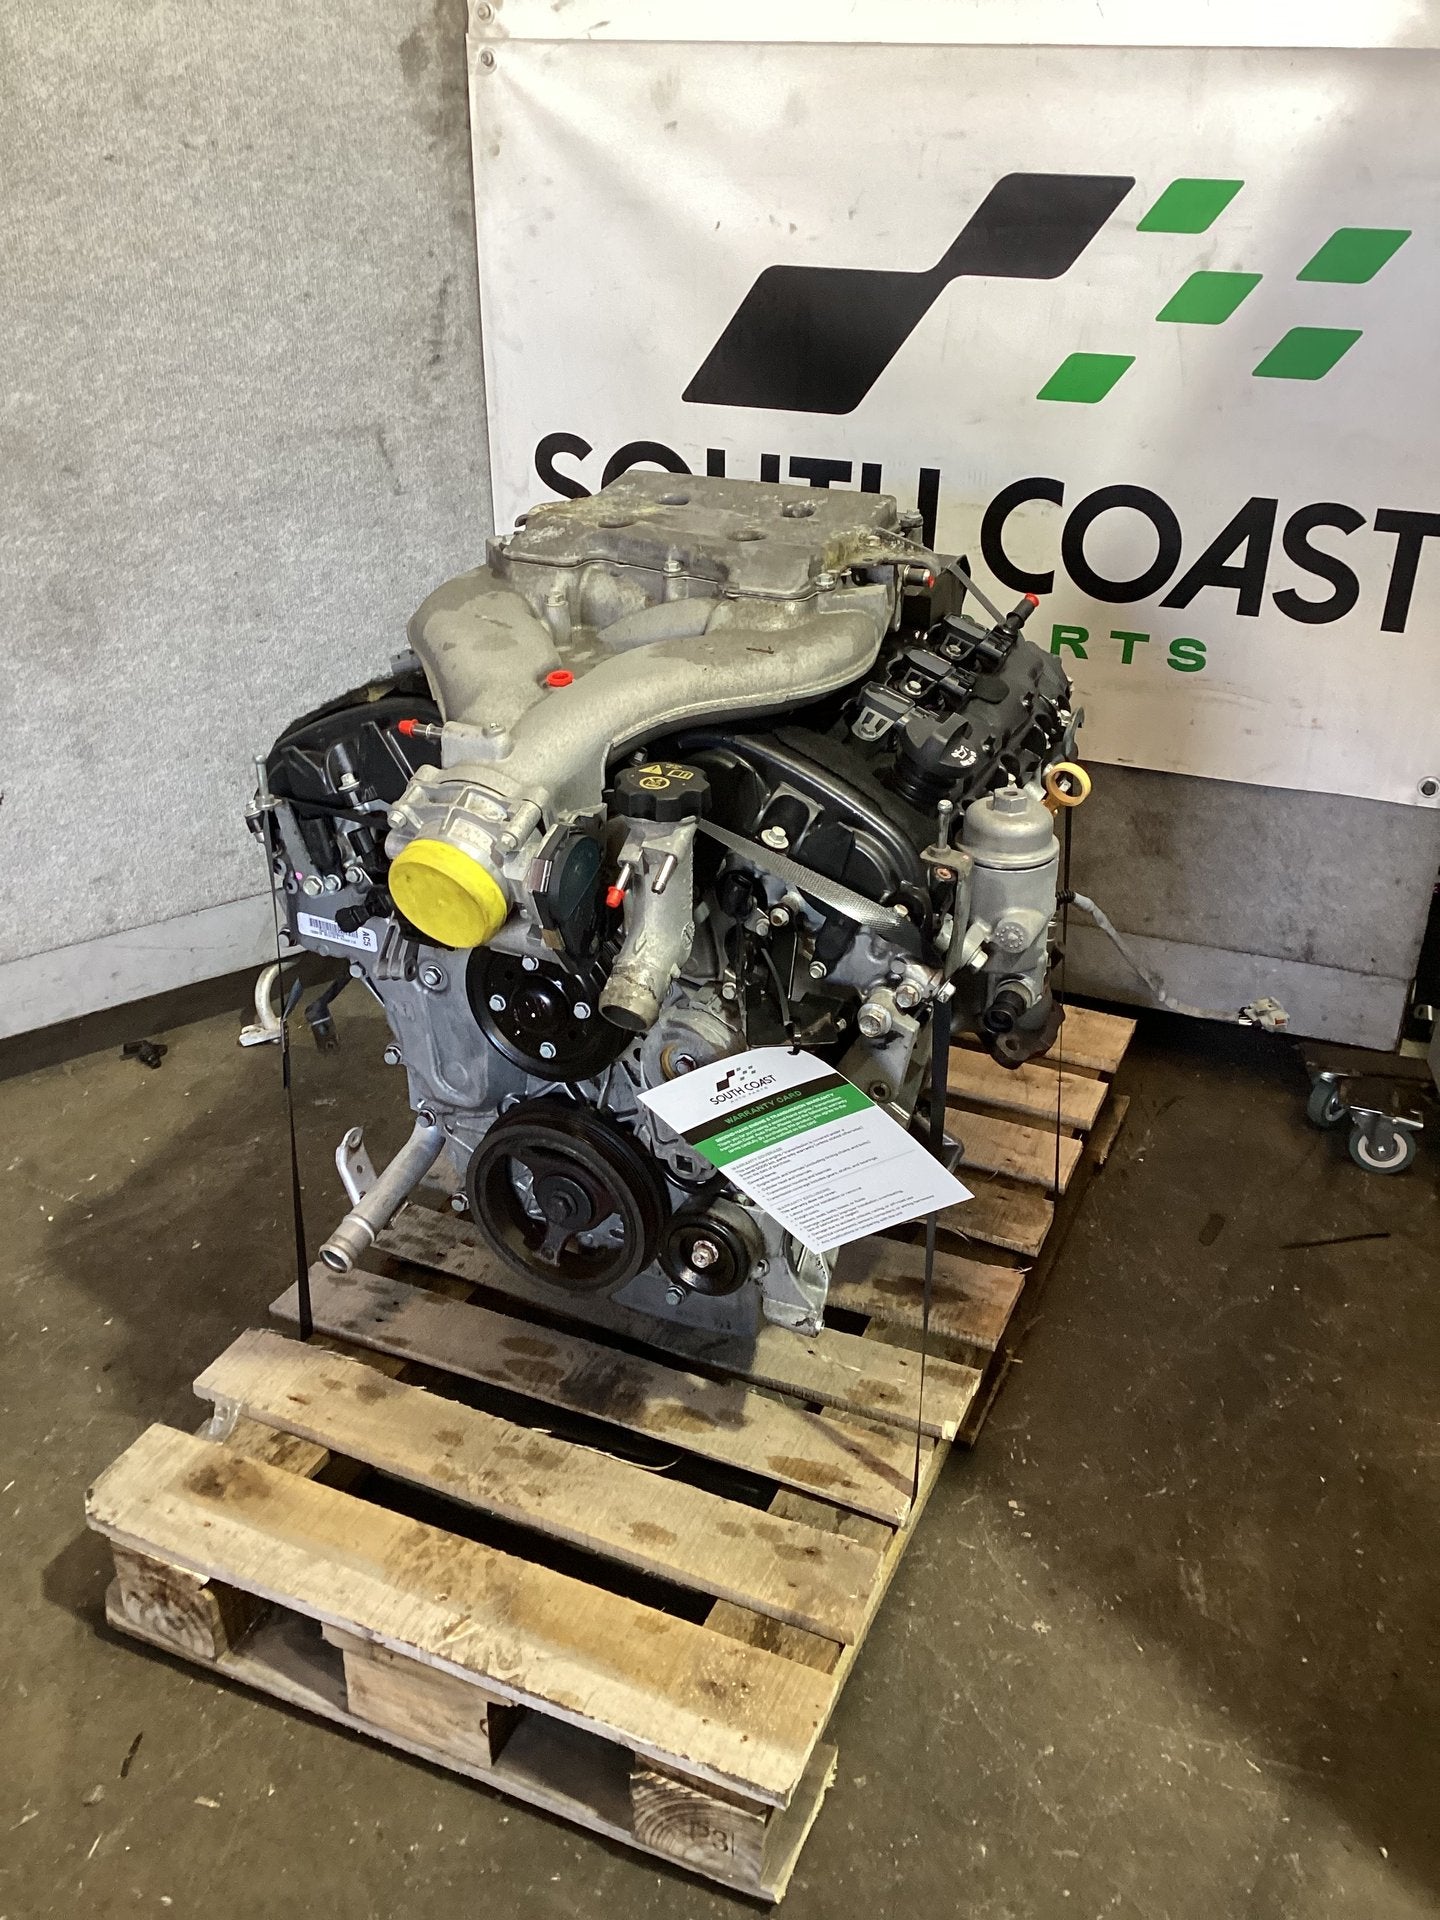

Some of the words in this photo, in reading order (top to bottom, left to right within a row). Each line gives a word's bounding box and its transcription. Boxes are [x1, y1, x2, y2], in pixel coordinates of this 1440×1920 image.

[980, 477, 1440, 633] COAST
[1050, 624, 1208, 673] RTS
[707, 1086, 746, 1105] SOUTH
[741, 1073, 778, 1092] COAST
[722, 1099, 777, 1124] WARRANTY
[774, 1089, 803, 1103] CARD
[804, 1091, 836, 1106] WARRANTY
